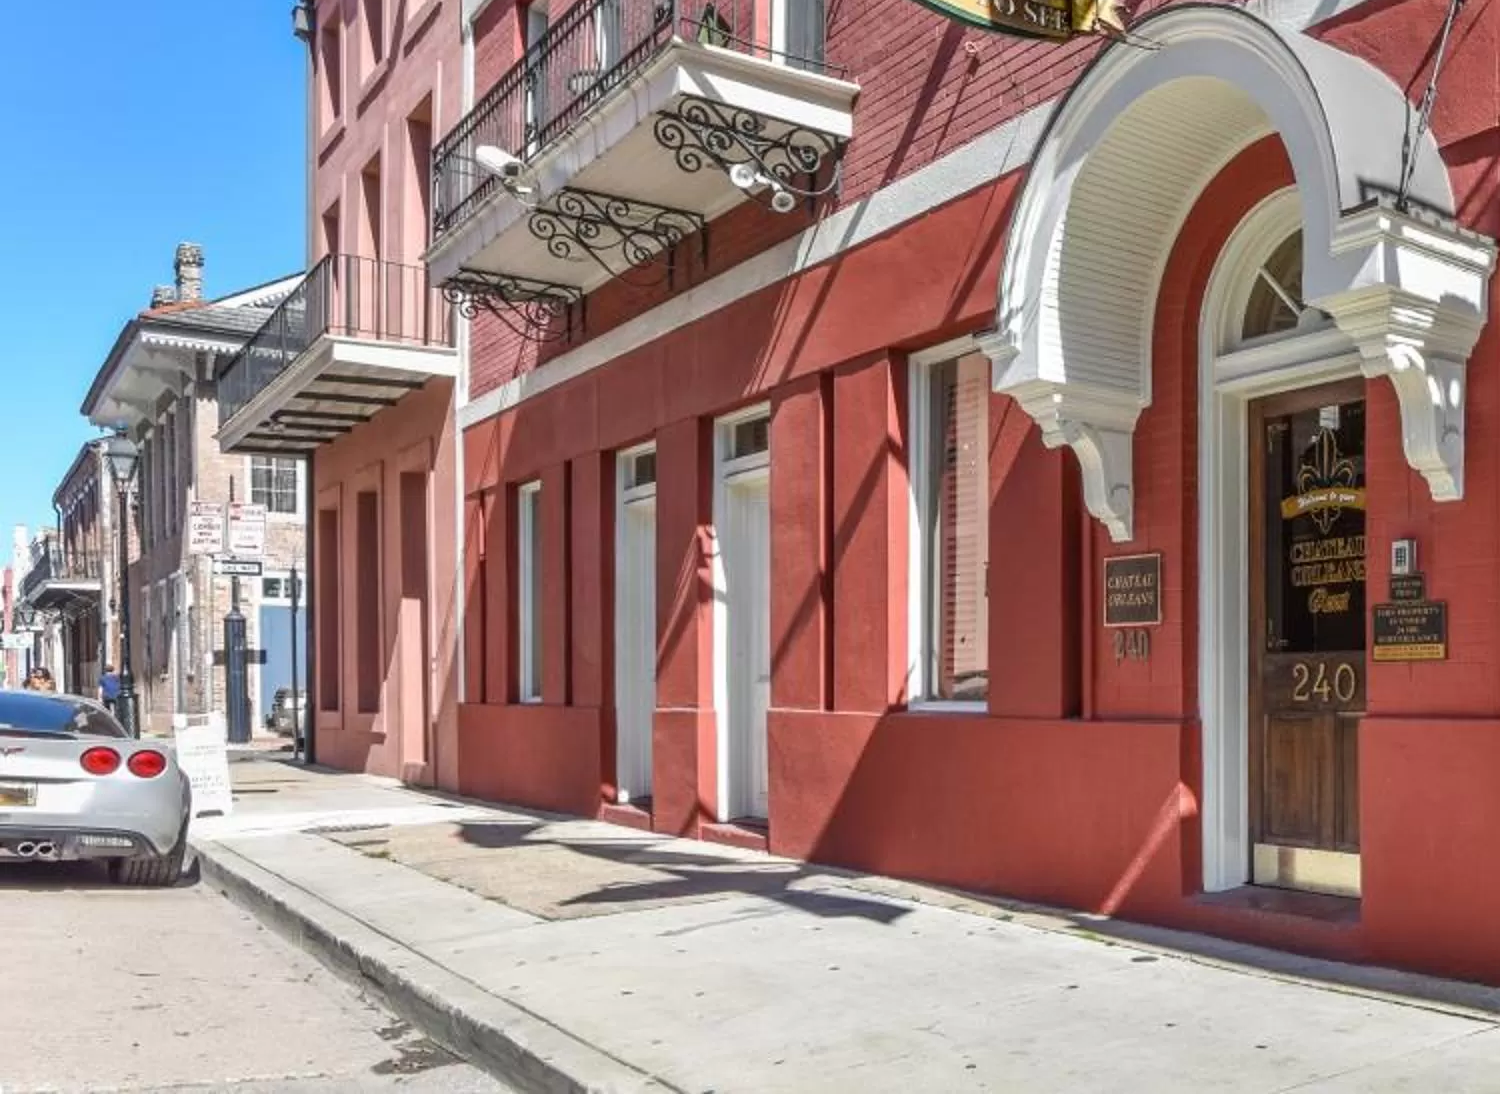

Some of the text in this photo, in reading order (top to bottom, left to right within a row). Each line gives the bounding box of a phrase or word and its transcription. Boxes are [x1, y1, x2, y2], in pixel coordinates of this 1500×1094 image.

[1023, 0, 1069, 32] SEE
[1108, 573, 1153, 589] CHATEAU
[1108, 592, 1154, 607] ORLEANS
[1293, 662, 1356, 704] 240
